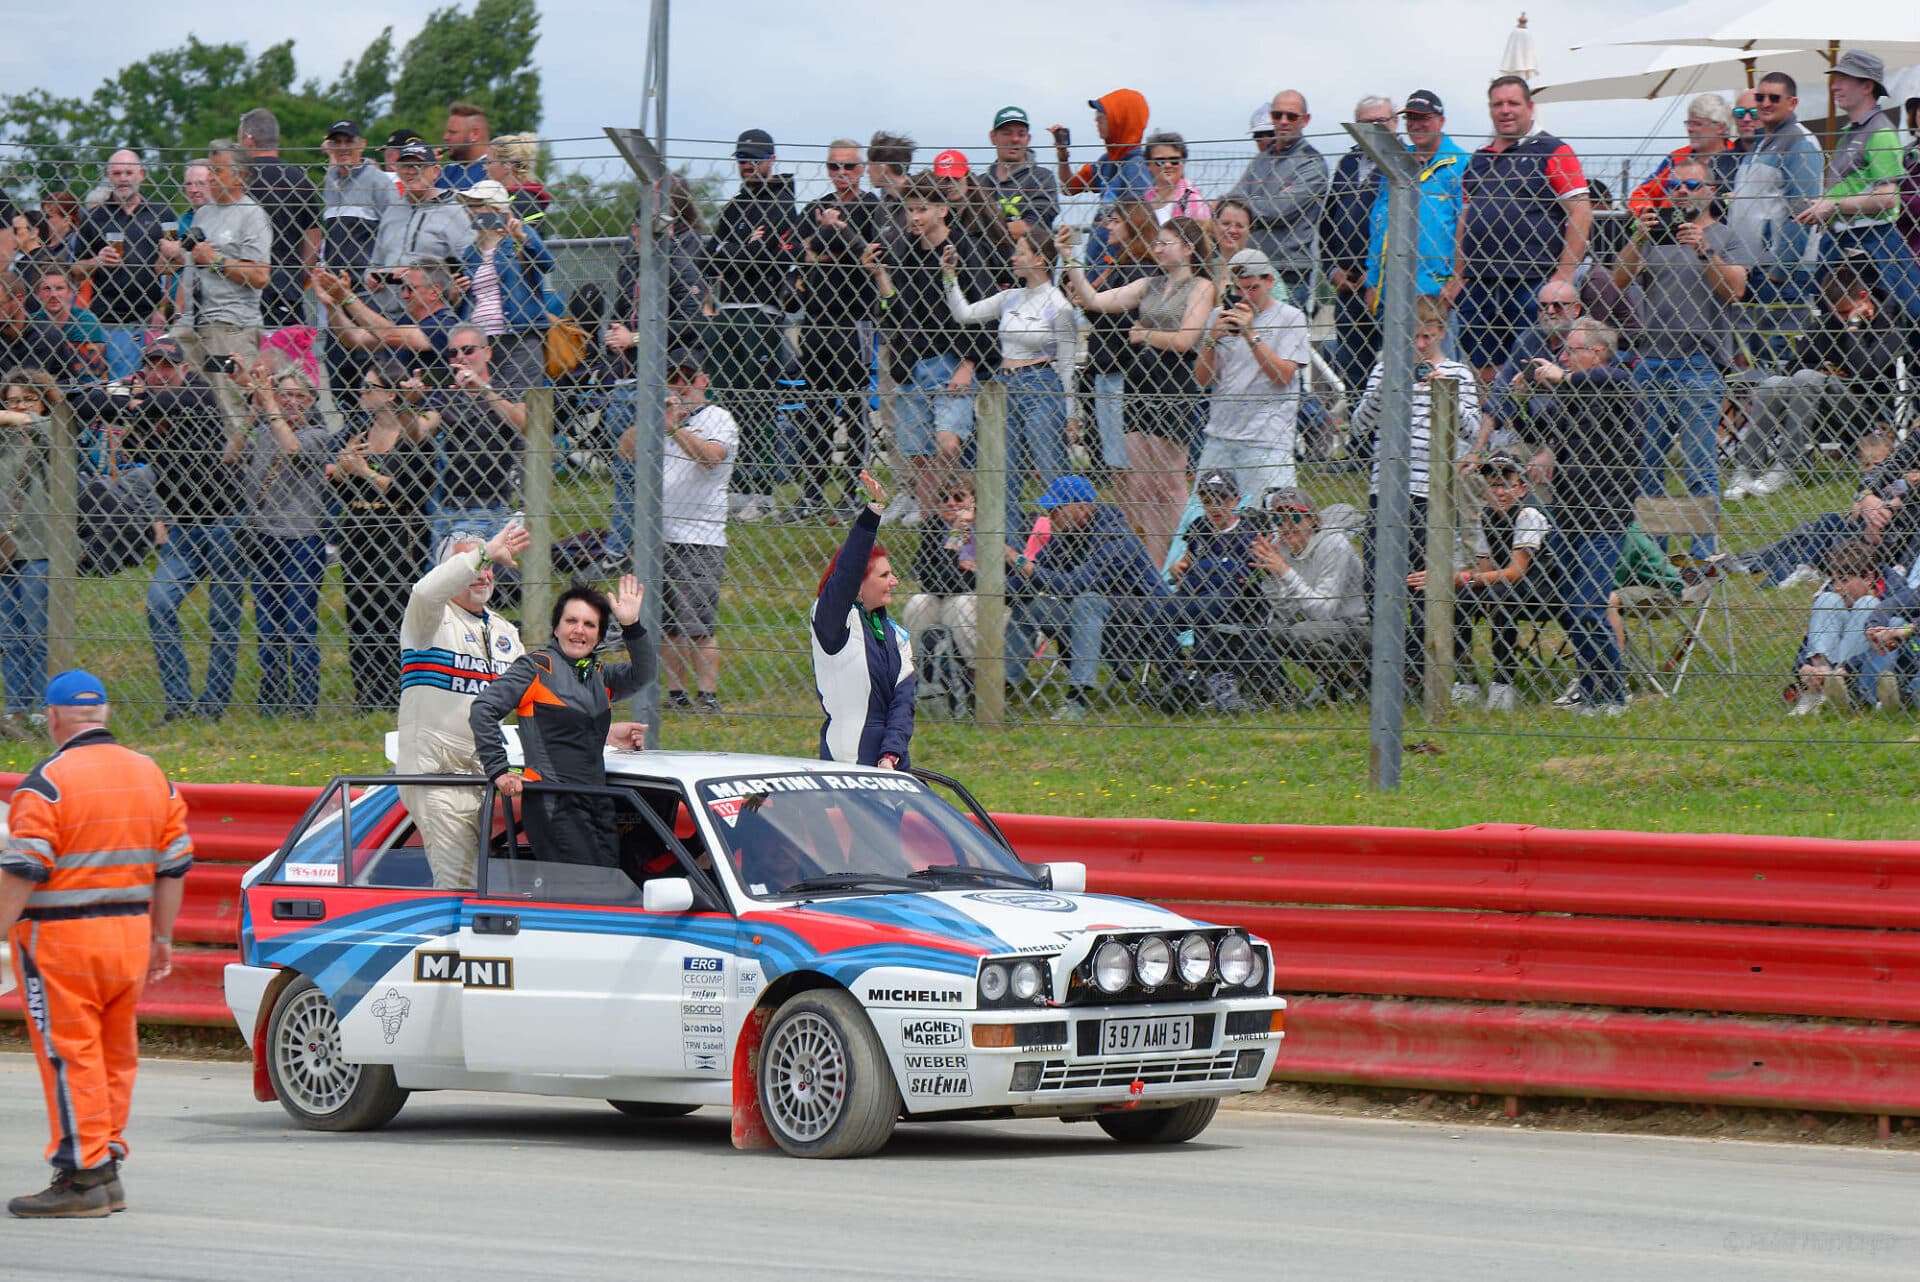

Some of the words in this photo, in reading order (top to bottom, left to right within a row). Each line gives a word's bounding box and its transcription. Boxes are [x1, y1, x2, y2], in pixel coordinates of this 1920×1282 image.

[708, 776, 821, 798] MARTINI
[822, 776, 921, 794] RACING
[714, 803, 739, 815] 112
[1018, 944, 1068, 952] MICHELI
[691, 959, 717, 970] ERG
[423, 956, 506, 985] MANI
[684, 974, 722, 984] CECOMP
[740, 973, 757, 982] SKF
[868, 989, 962, 1002] MICHELIN
[683, 1004, 722, 1014] sparco
[684, 1023, 722, 1033] brembo
[1108, 1024, 1141, 1048] 397
[1143, 1023, 1167, 1047] AAH
[1172, 1021, 1190, 1045] 51
[685, 1041, 700, 1049] TRW
[702, 1041, 723, 1050] Sabelt
[906, 1056, 967, 1068] WEBER
